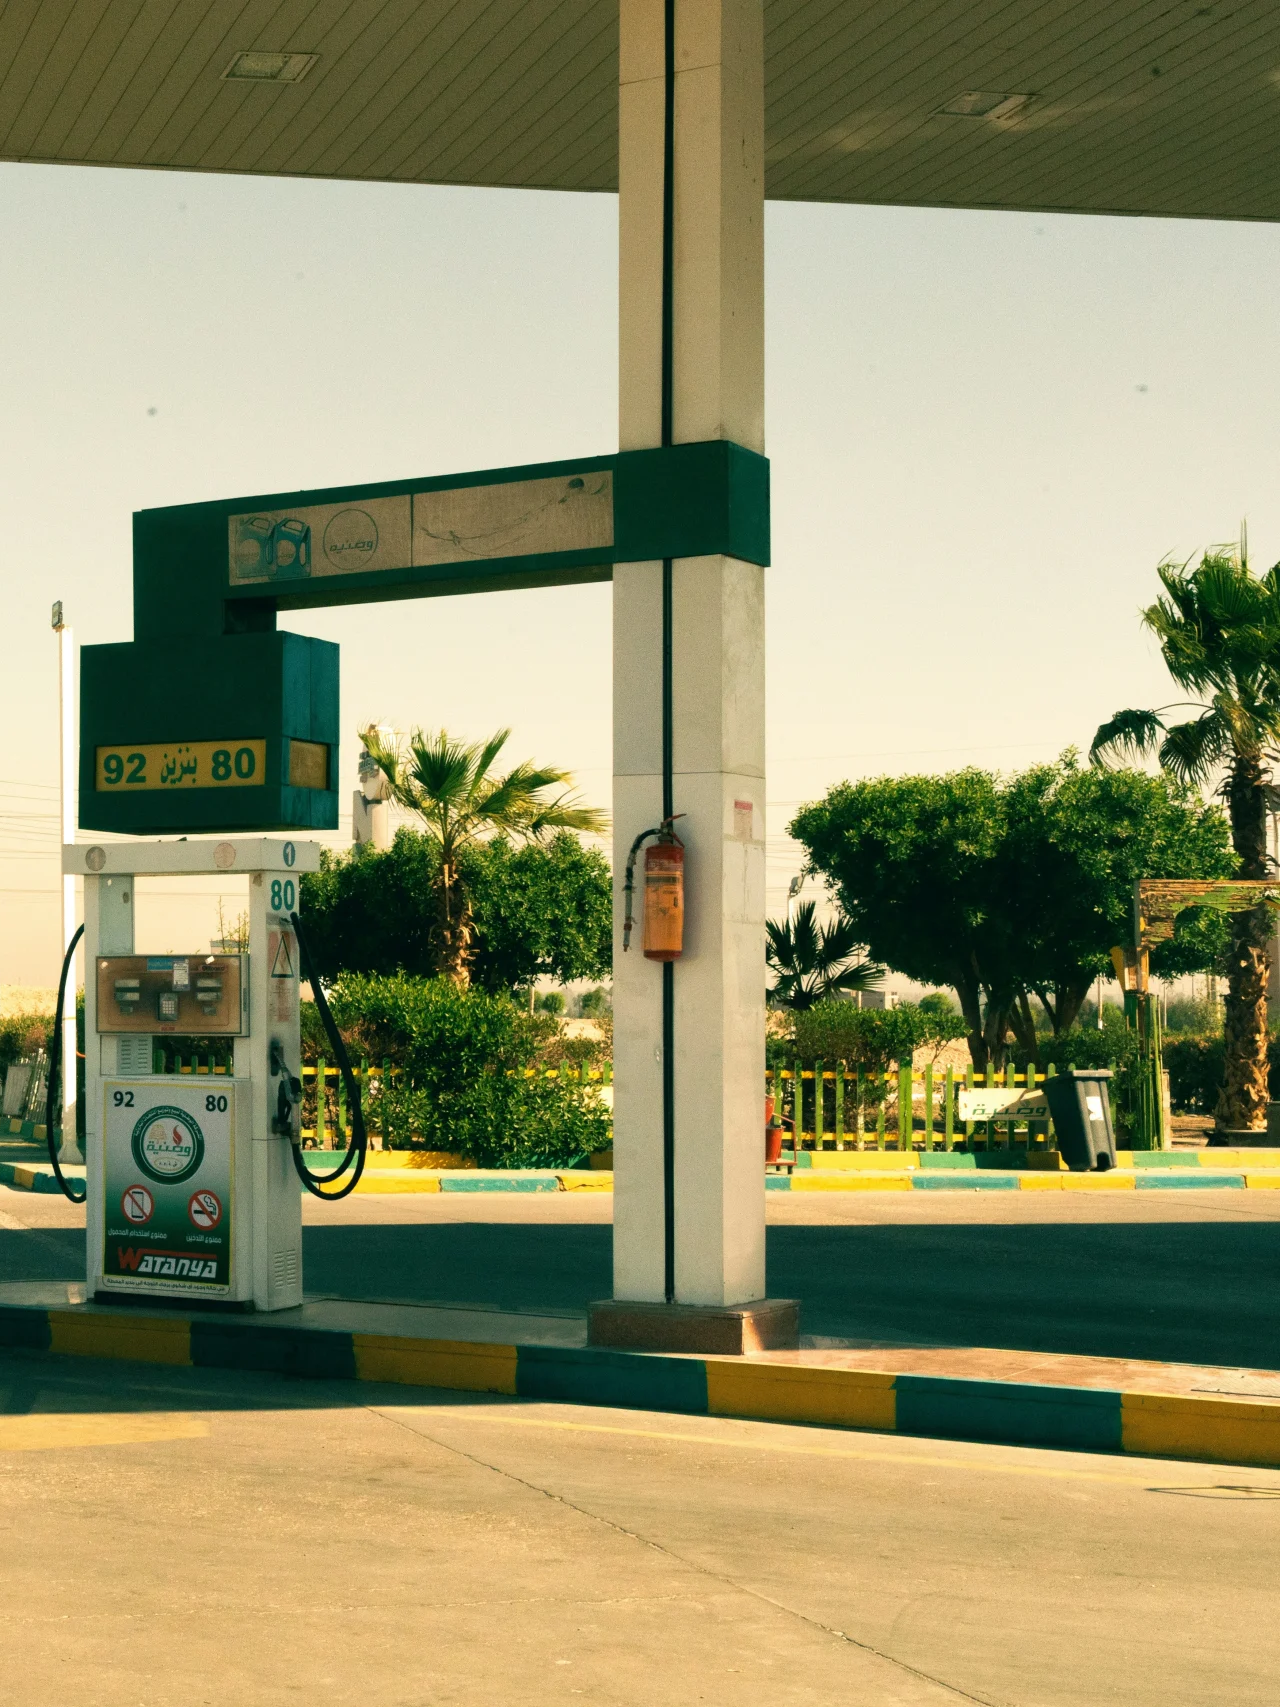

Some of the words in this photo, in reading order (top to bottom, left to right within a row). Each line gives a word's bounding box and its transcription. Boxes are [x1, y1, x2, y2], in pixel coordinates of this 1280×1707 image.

[103, 753, 147, 784] 92
[160, 746, 197, 784] بنزين
[211, 747, 256, 782] 80
[270, 879, 295, 911] 80
[113, 1090, 135, 1108] 92
[205, 1094, 228, 1112] 80
